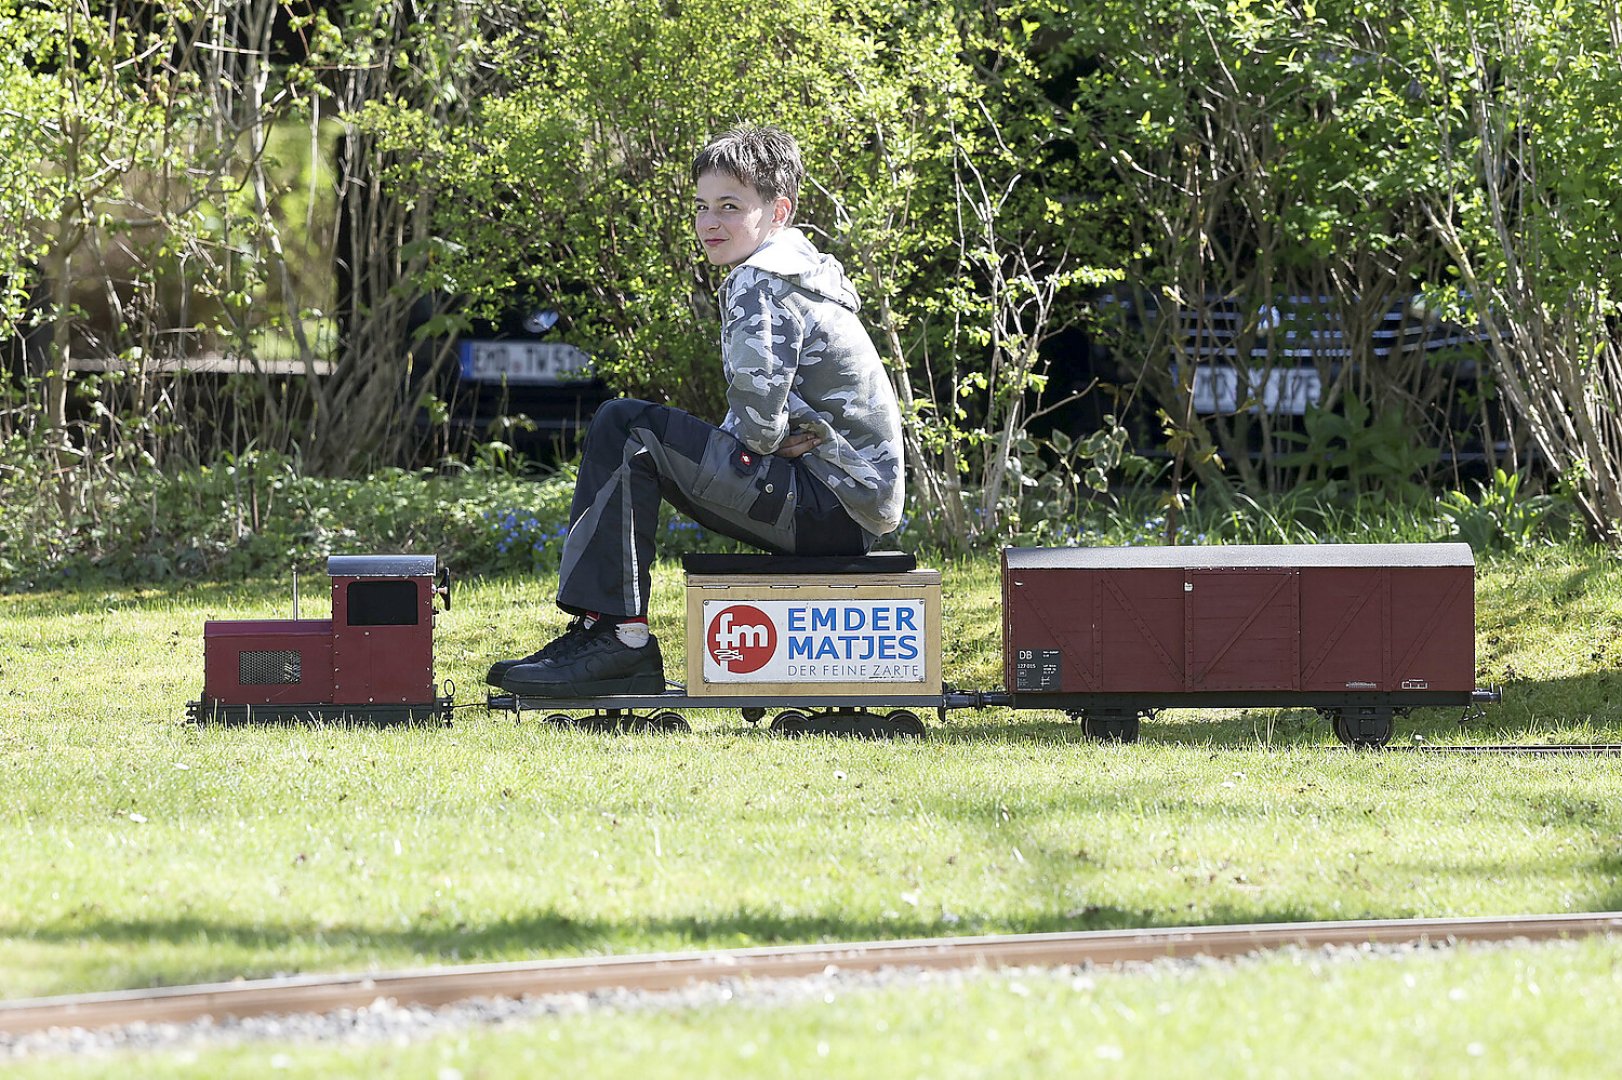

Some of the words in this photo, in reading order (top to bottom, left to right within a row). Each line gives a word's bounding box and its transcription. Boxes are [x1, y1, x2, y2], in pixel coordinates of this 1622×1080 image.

[715, 612, 769, 650] fm
[787, 607, 918, 632] EMDER
[787, 635, 919, 660] MATJES
[1019, 650, 1033, 660] DB
[788, 665, 816, 676] DER
[823, 665, 867, 676] FEINE
[873, 664, 919, 677] ZARTE
